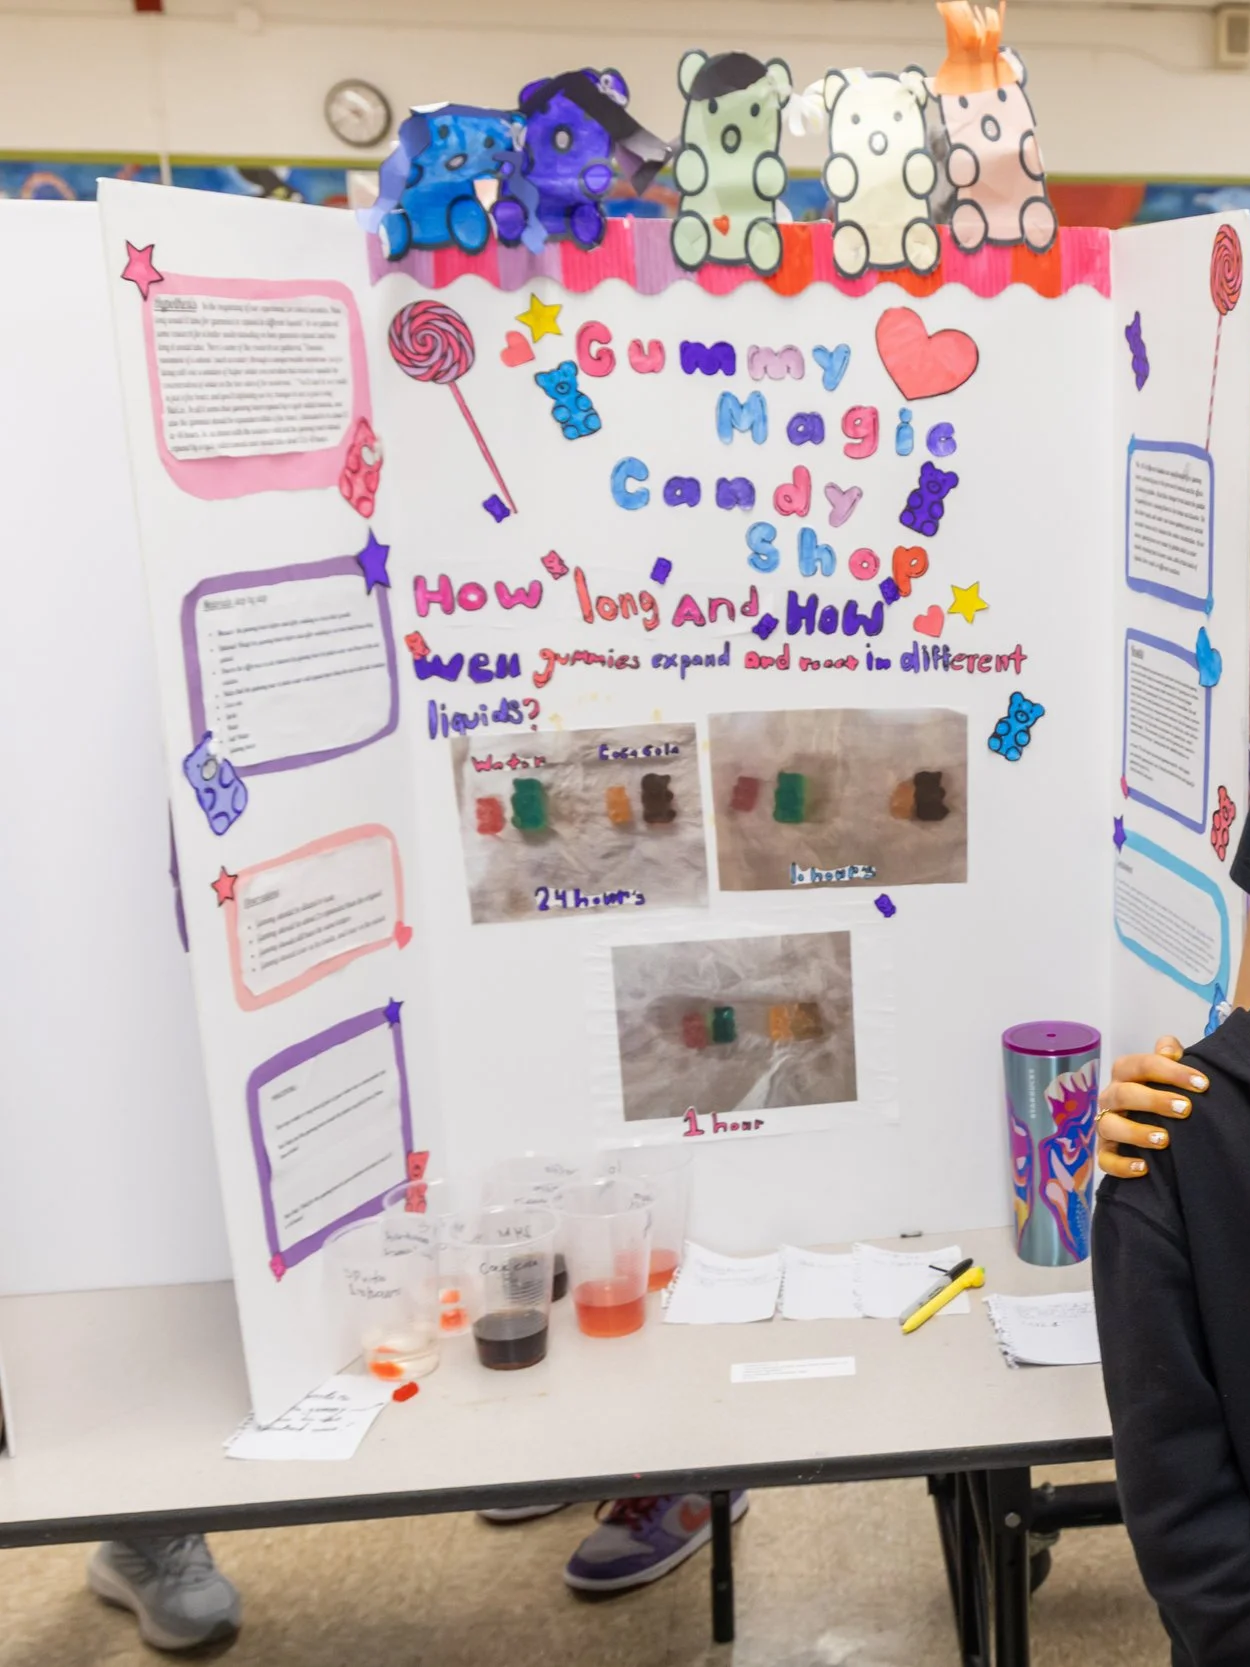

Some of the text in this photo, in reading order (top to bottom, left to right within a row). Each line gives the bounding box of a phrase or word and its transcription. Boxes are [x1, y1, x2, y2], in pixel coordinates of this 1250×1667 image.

[575, 320, 851, 392] Gummy
[716, 390, 958, 459] Magic
[610, 456, 864, 528] Candy
[745, 521, 929, 598] Shop
[573, 566, 661, 632] long
[671, 585, 760, 628] And
[532, 648, 641, 689] gummies
[650, 640, 731, 681] expand
[743, 641, 791, 671] and
[865, 642, 892, 672] in
[899, 639, 1028, 675] different
[427, 697, 541, 741] liquids?
[534, 885, 568, 912] 24
[682, 1106, 765, 1137] 1 hour
